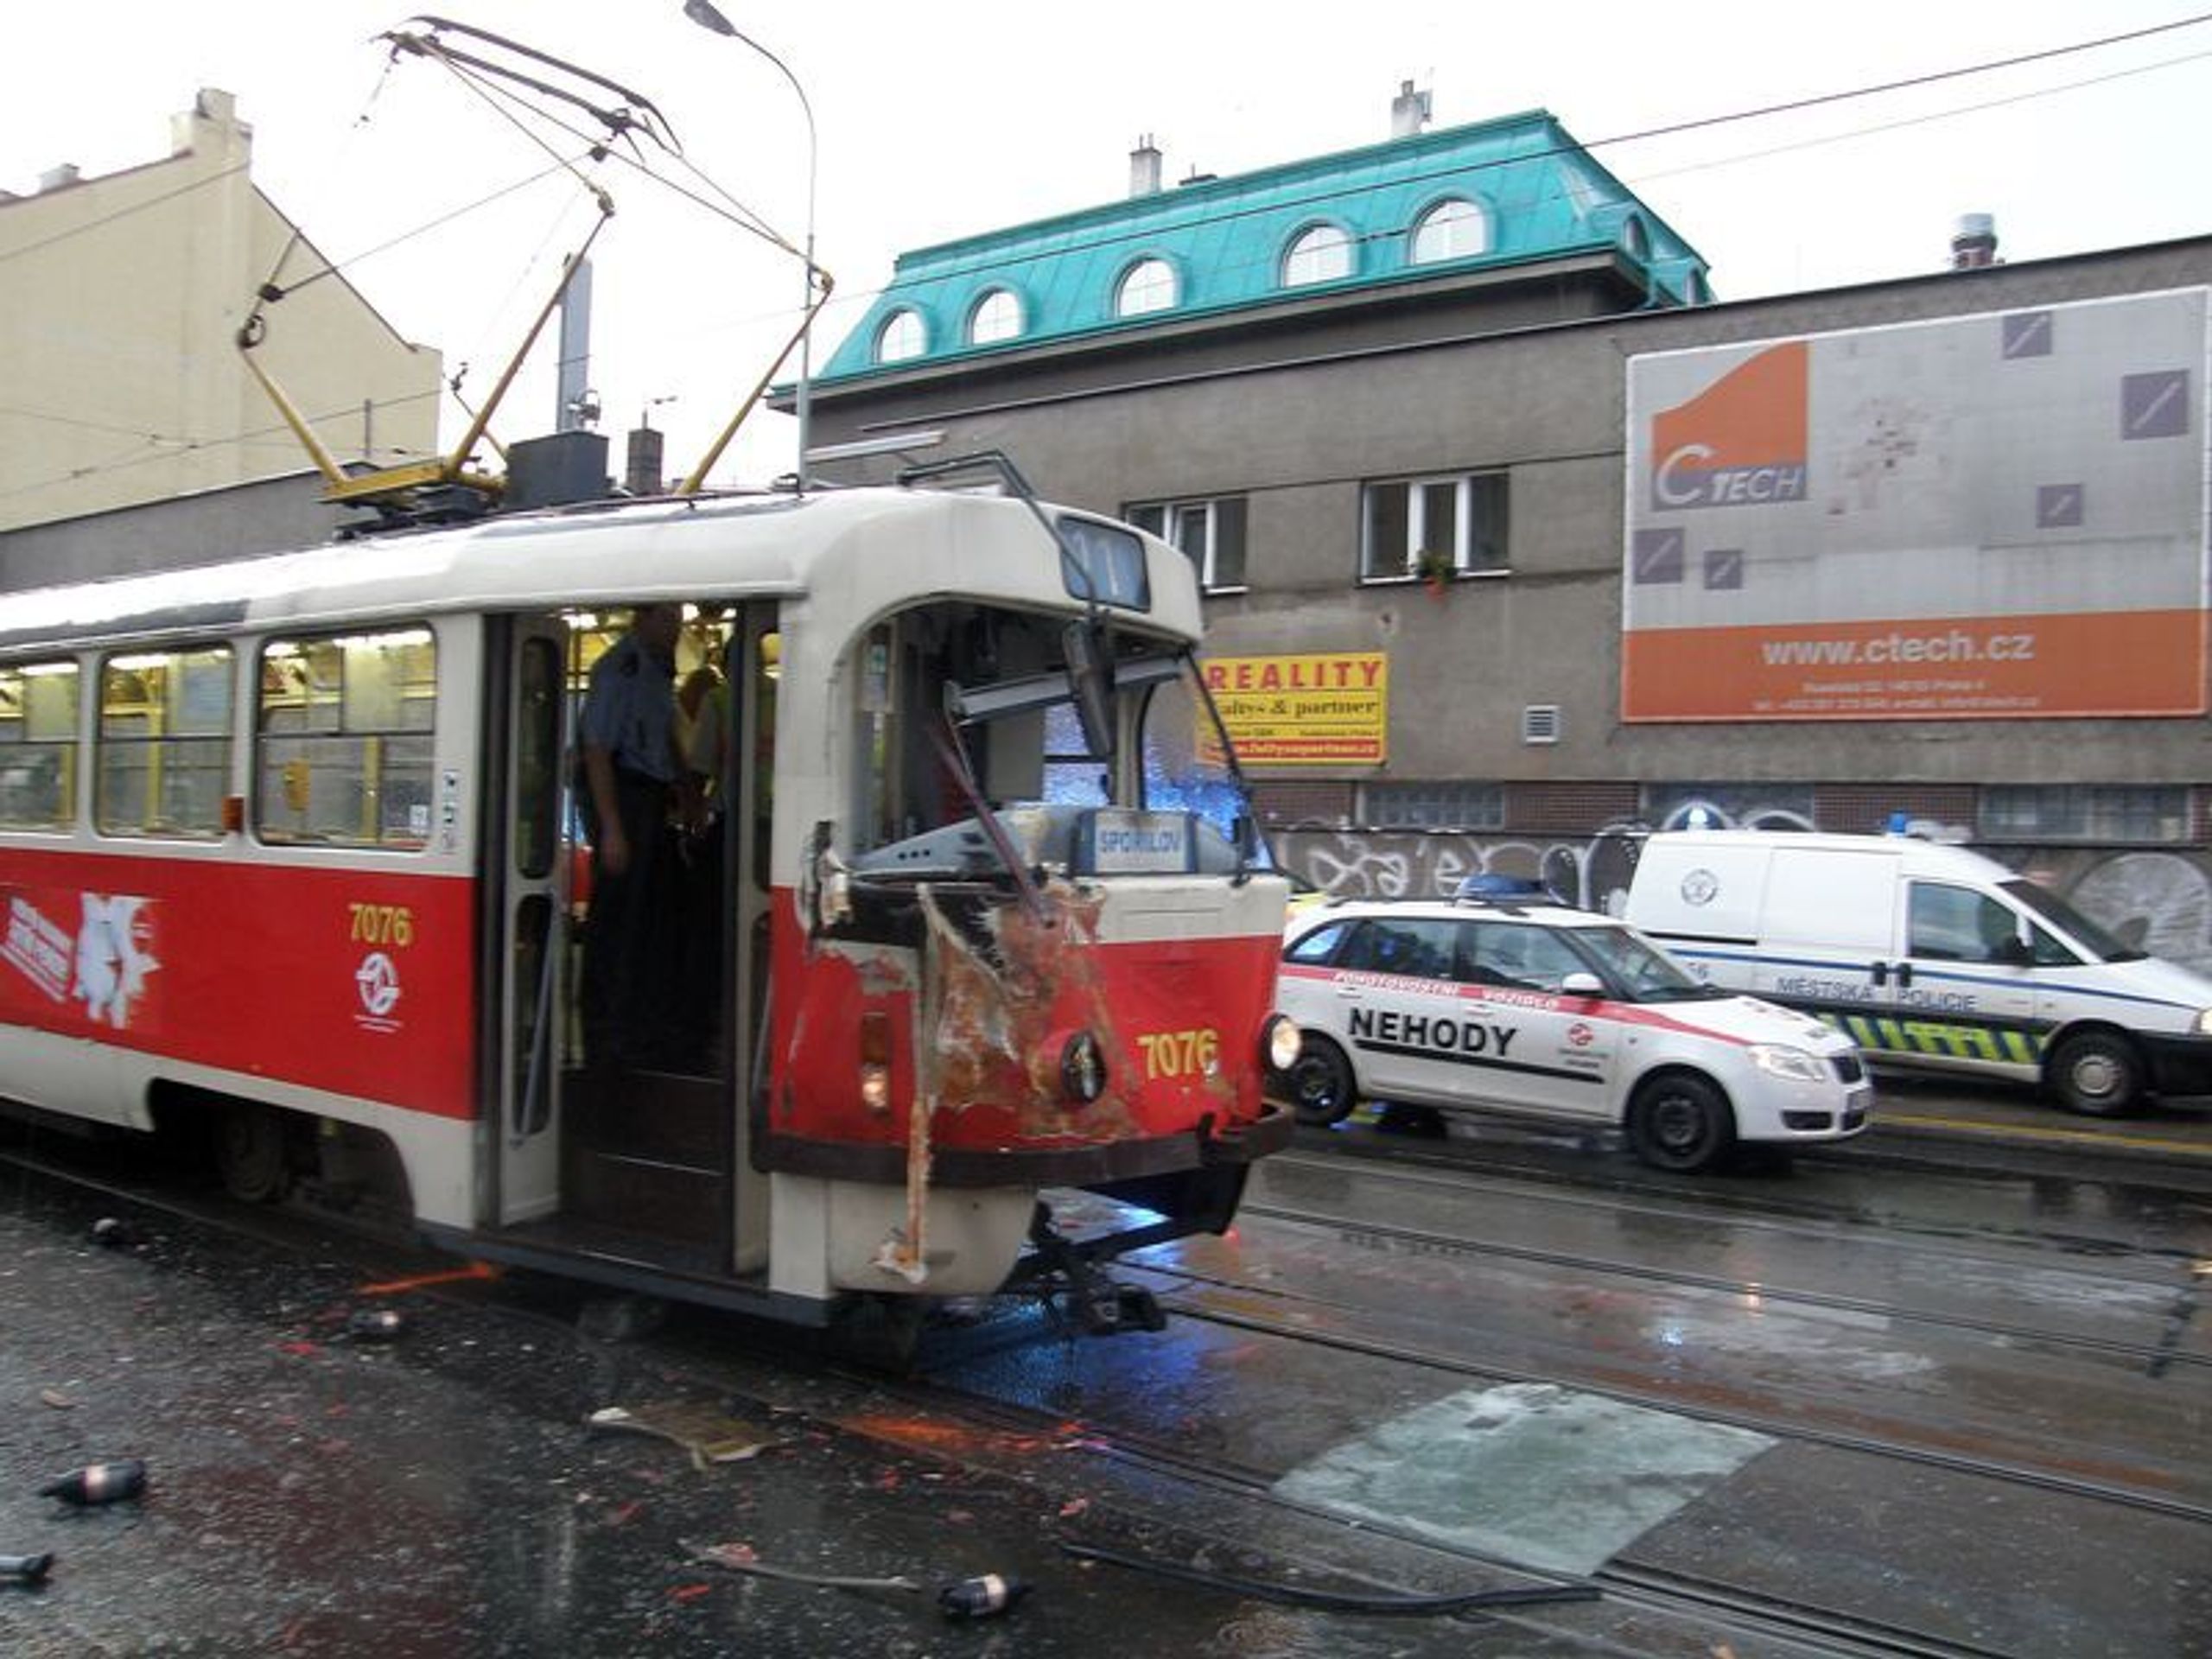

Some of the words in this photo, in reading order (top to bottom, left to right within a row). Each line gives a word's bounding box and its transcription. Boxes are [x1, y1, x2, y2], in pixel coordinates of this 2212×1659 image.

[1763, 631, 2035, 664] www.ctech.cz
[1206, 661, 1382, 690] REALITY
[1296, 701, 1380, 719] partner
[348, 903, 413, 945] 7076
[1349, 1007, 1518, 1057] NEHODY
[1135, 1028, 1218, 1080] 7076
